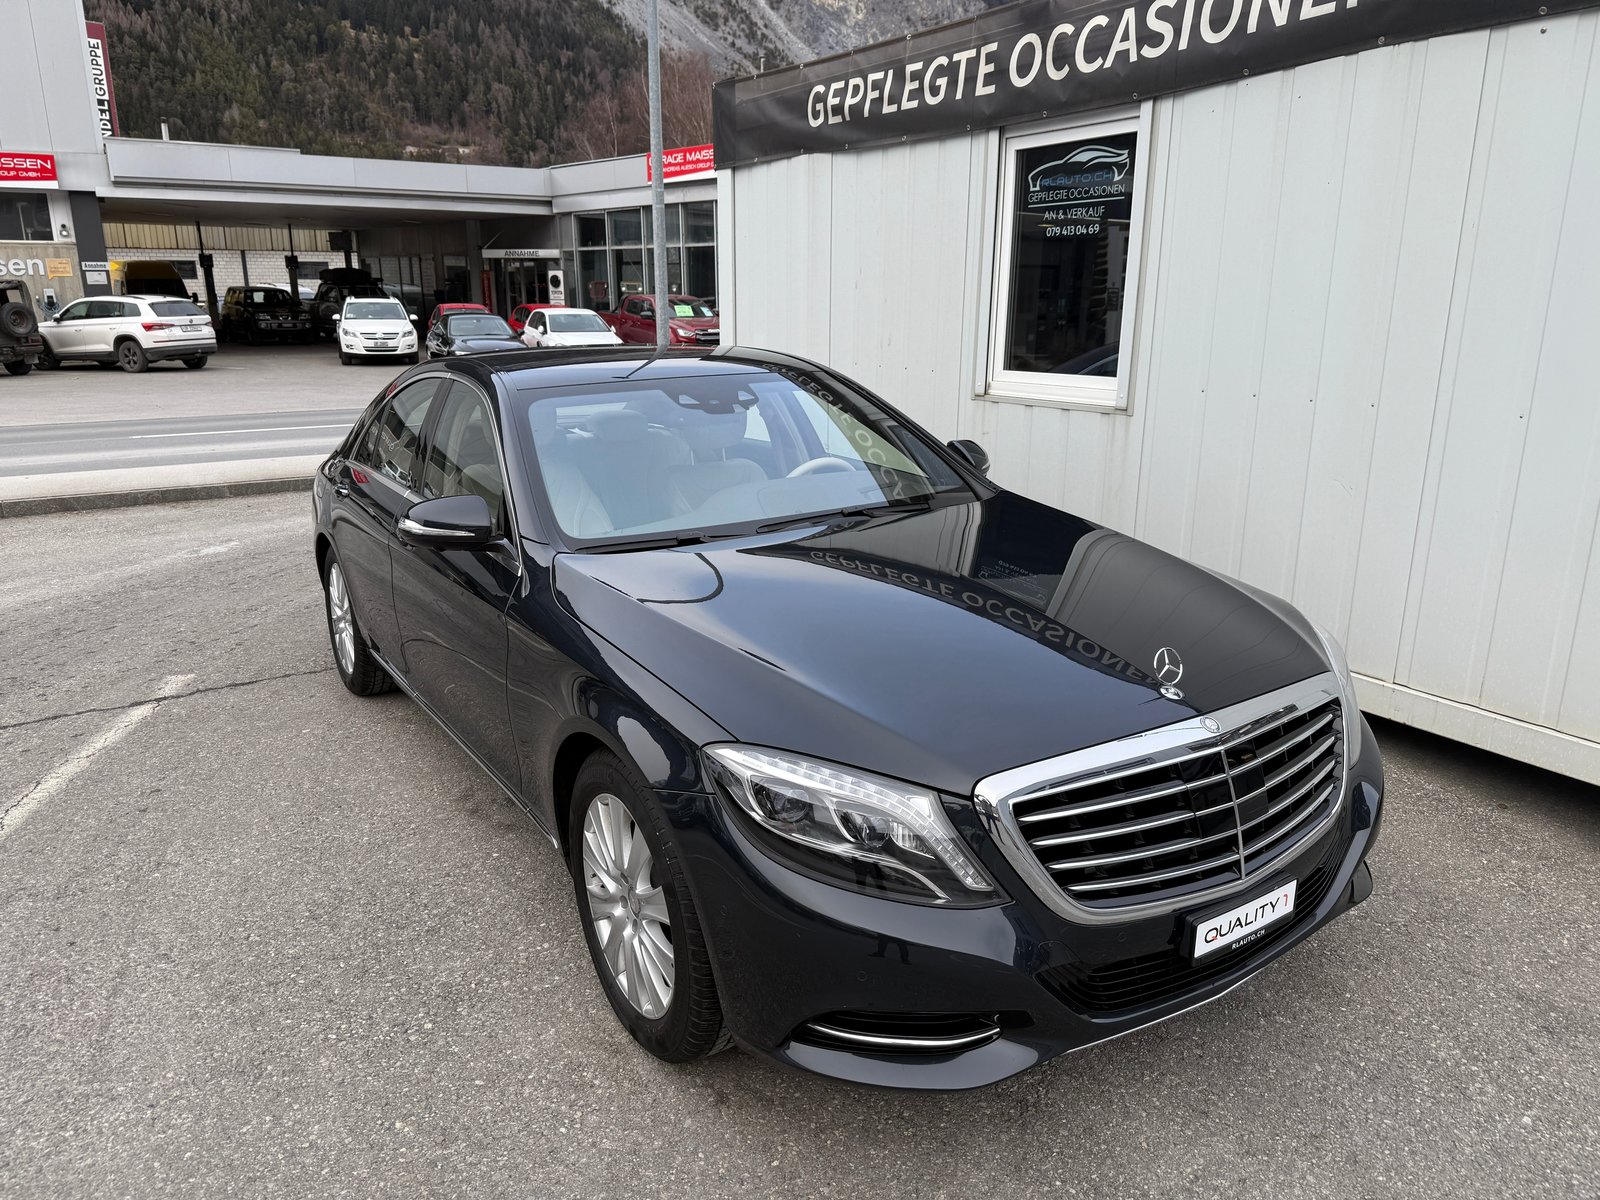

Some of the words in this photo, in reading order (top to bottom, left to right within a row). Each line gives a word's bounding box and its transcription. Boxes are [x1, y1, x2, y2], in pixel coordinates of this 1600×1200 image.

[88, 40, 106, 97] GRUPPE
[807, 42, 998, 127] GEPFLEGTE
[1009, 0, 1358, 88] OCCASIO
[649, 153, 684, 166] RAGE
[1041, 170, 1113, 187] RLAUTO.CH
[1027, 189, 1068, 203] GEPFLEGTE
[1069, 184, 1125, 198] OCCASIONEN
[1043, 210, 1057, 221] AN
[1058, 210, 1065, 220] &
[1066, 206, 1105, 219] VERKAUF
[1046, 227, 1061, 237] 079
[1062, 225, 1075, 236] 413
[1076, 225, 1087, 235] 04
[1088, 223, 1100, 235] 69
[1204, 897, 1280, 944] QUALITY
[1283, 893, 1289, 907] 1
[1231, 929, 1266, 950] RLAUTO.CH
